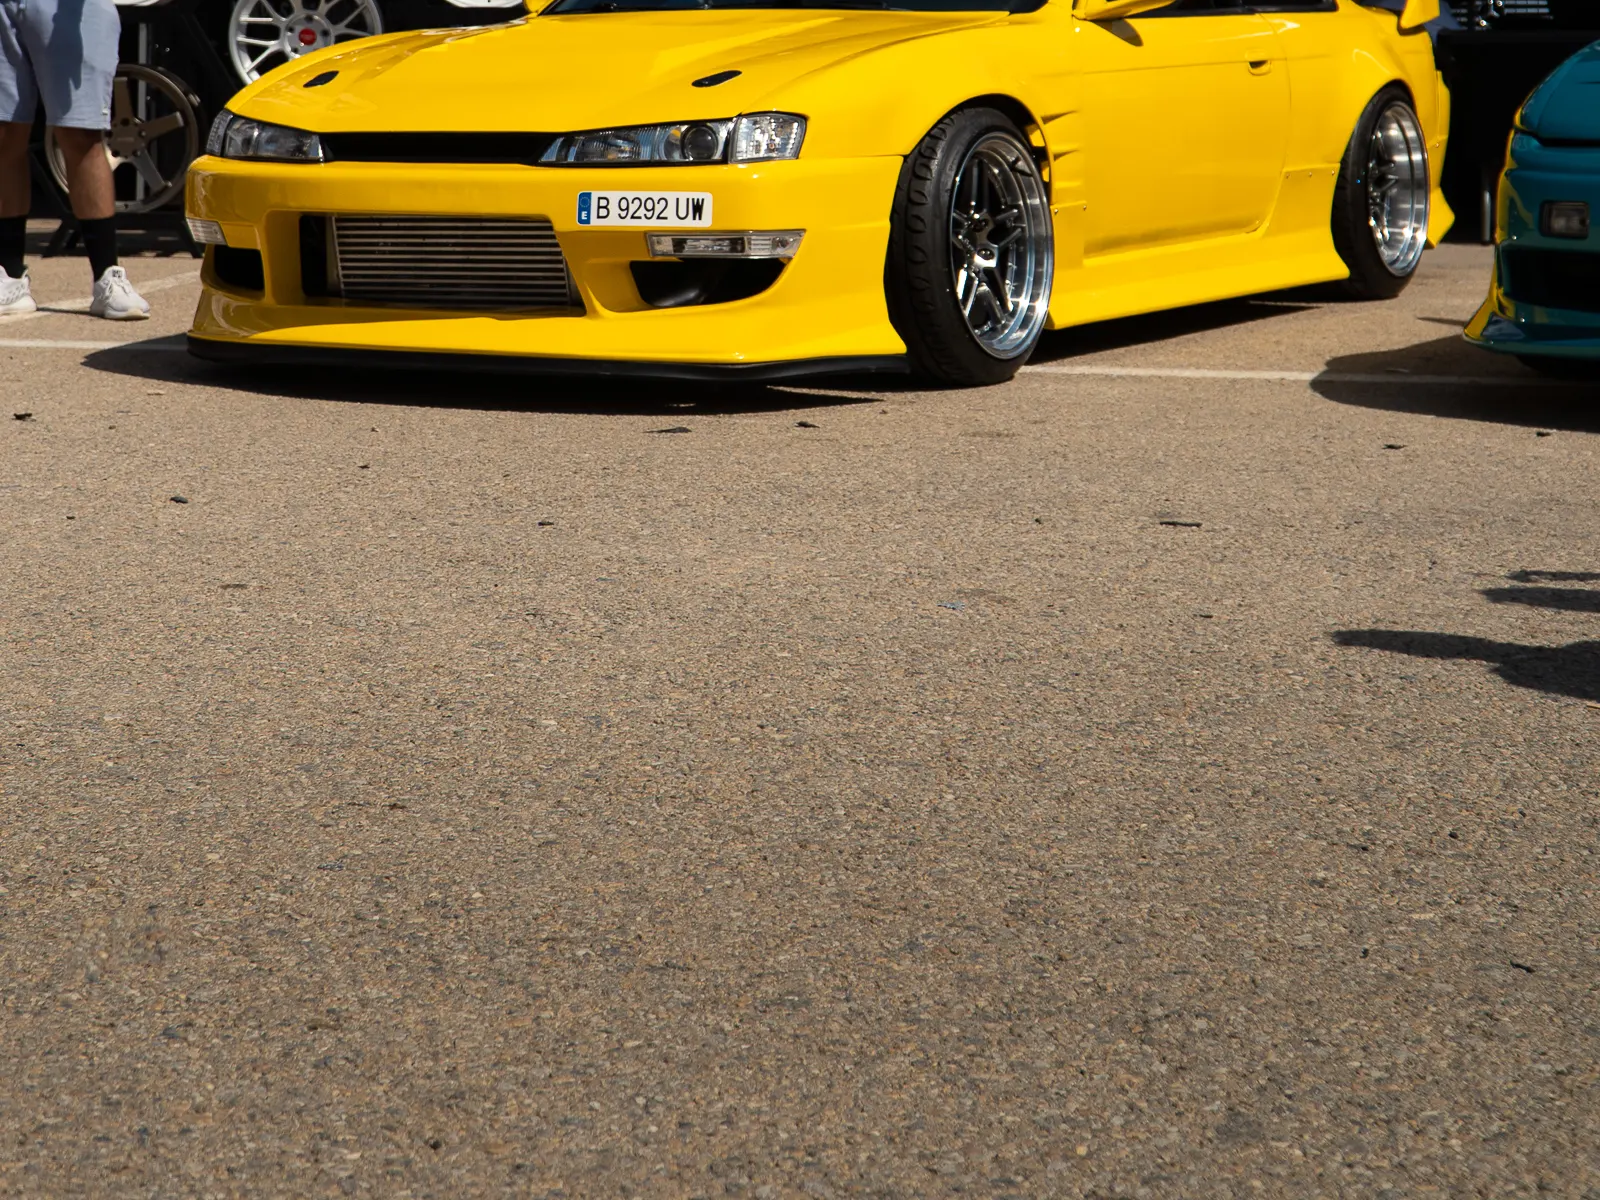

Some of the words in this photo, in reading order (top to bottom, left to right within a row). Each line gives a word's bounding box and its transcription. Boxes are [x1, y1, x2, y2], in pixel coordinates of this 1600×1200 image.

[597, 197, 610, 219] B
[618, 197, 668, 220] 9292
[676, 197, 705, 221] UW
